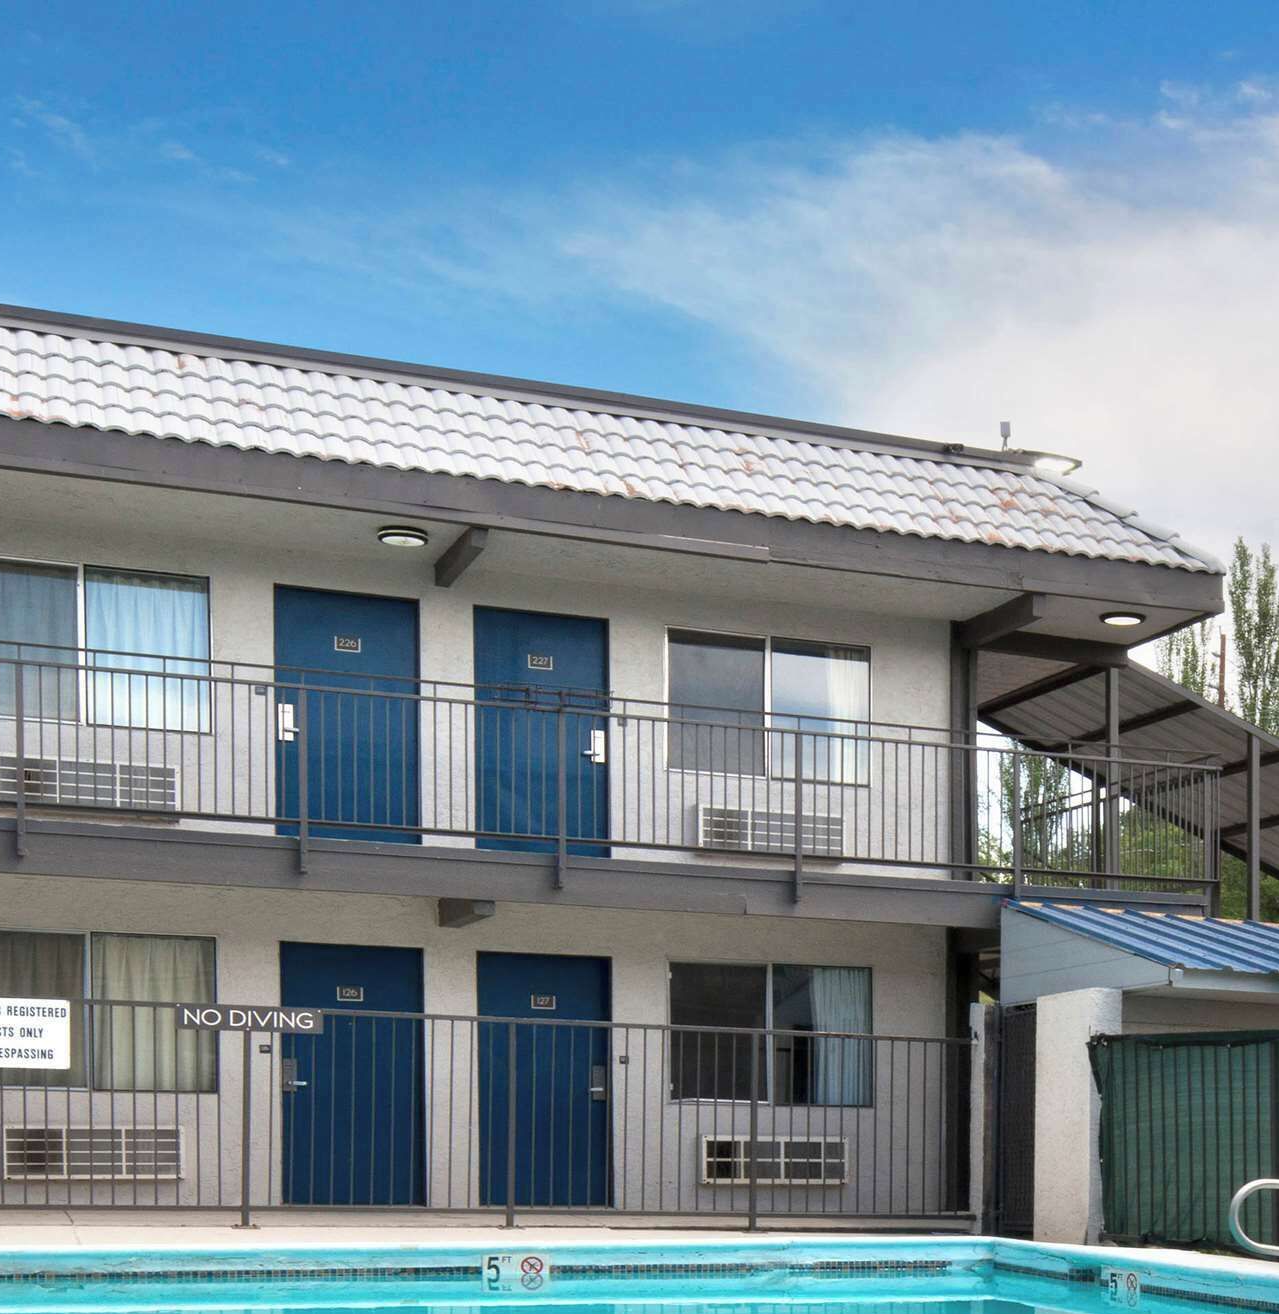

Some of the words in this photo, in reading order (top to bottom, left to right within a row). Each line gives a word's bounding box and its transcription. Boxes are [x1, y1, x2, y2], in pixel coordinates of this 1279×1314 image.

[339, 638, 357, 648] 226
[532, 656, 549, 665] 227
[343, 988, 358, 997] 126
[537, 996, 550, 1005] 127
[7, 1006, 67, 1018] REGISTERED
[183, 1008, 222, 1026] NO
[229, 1009, 314, 1029] DIVING
[20, 1027, 43, 1038] ONLY
[487, 1256, 500, 1279] 5
